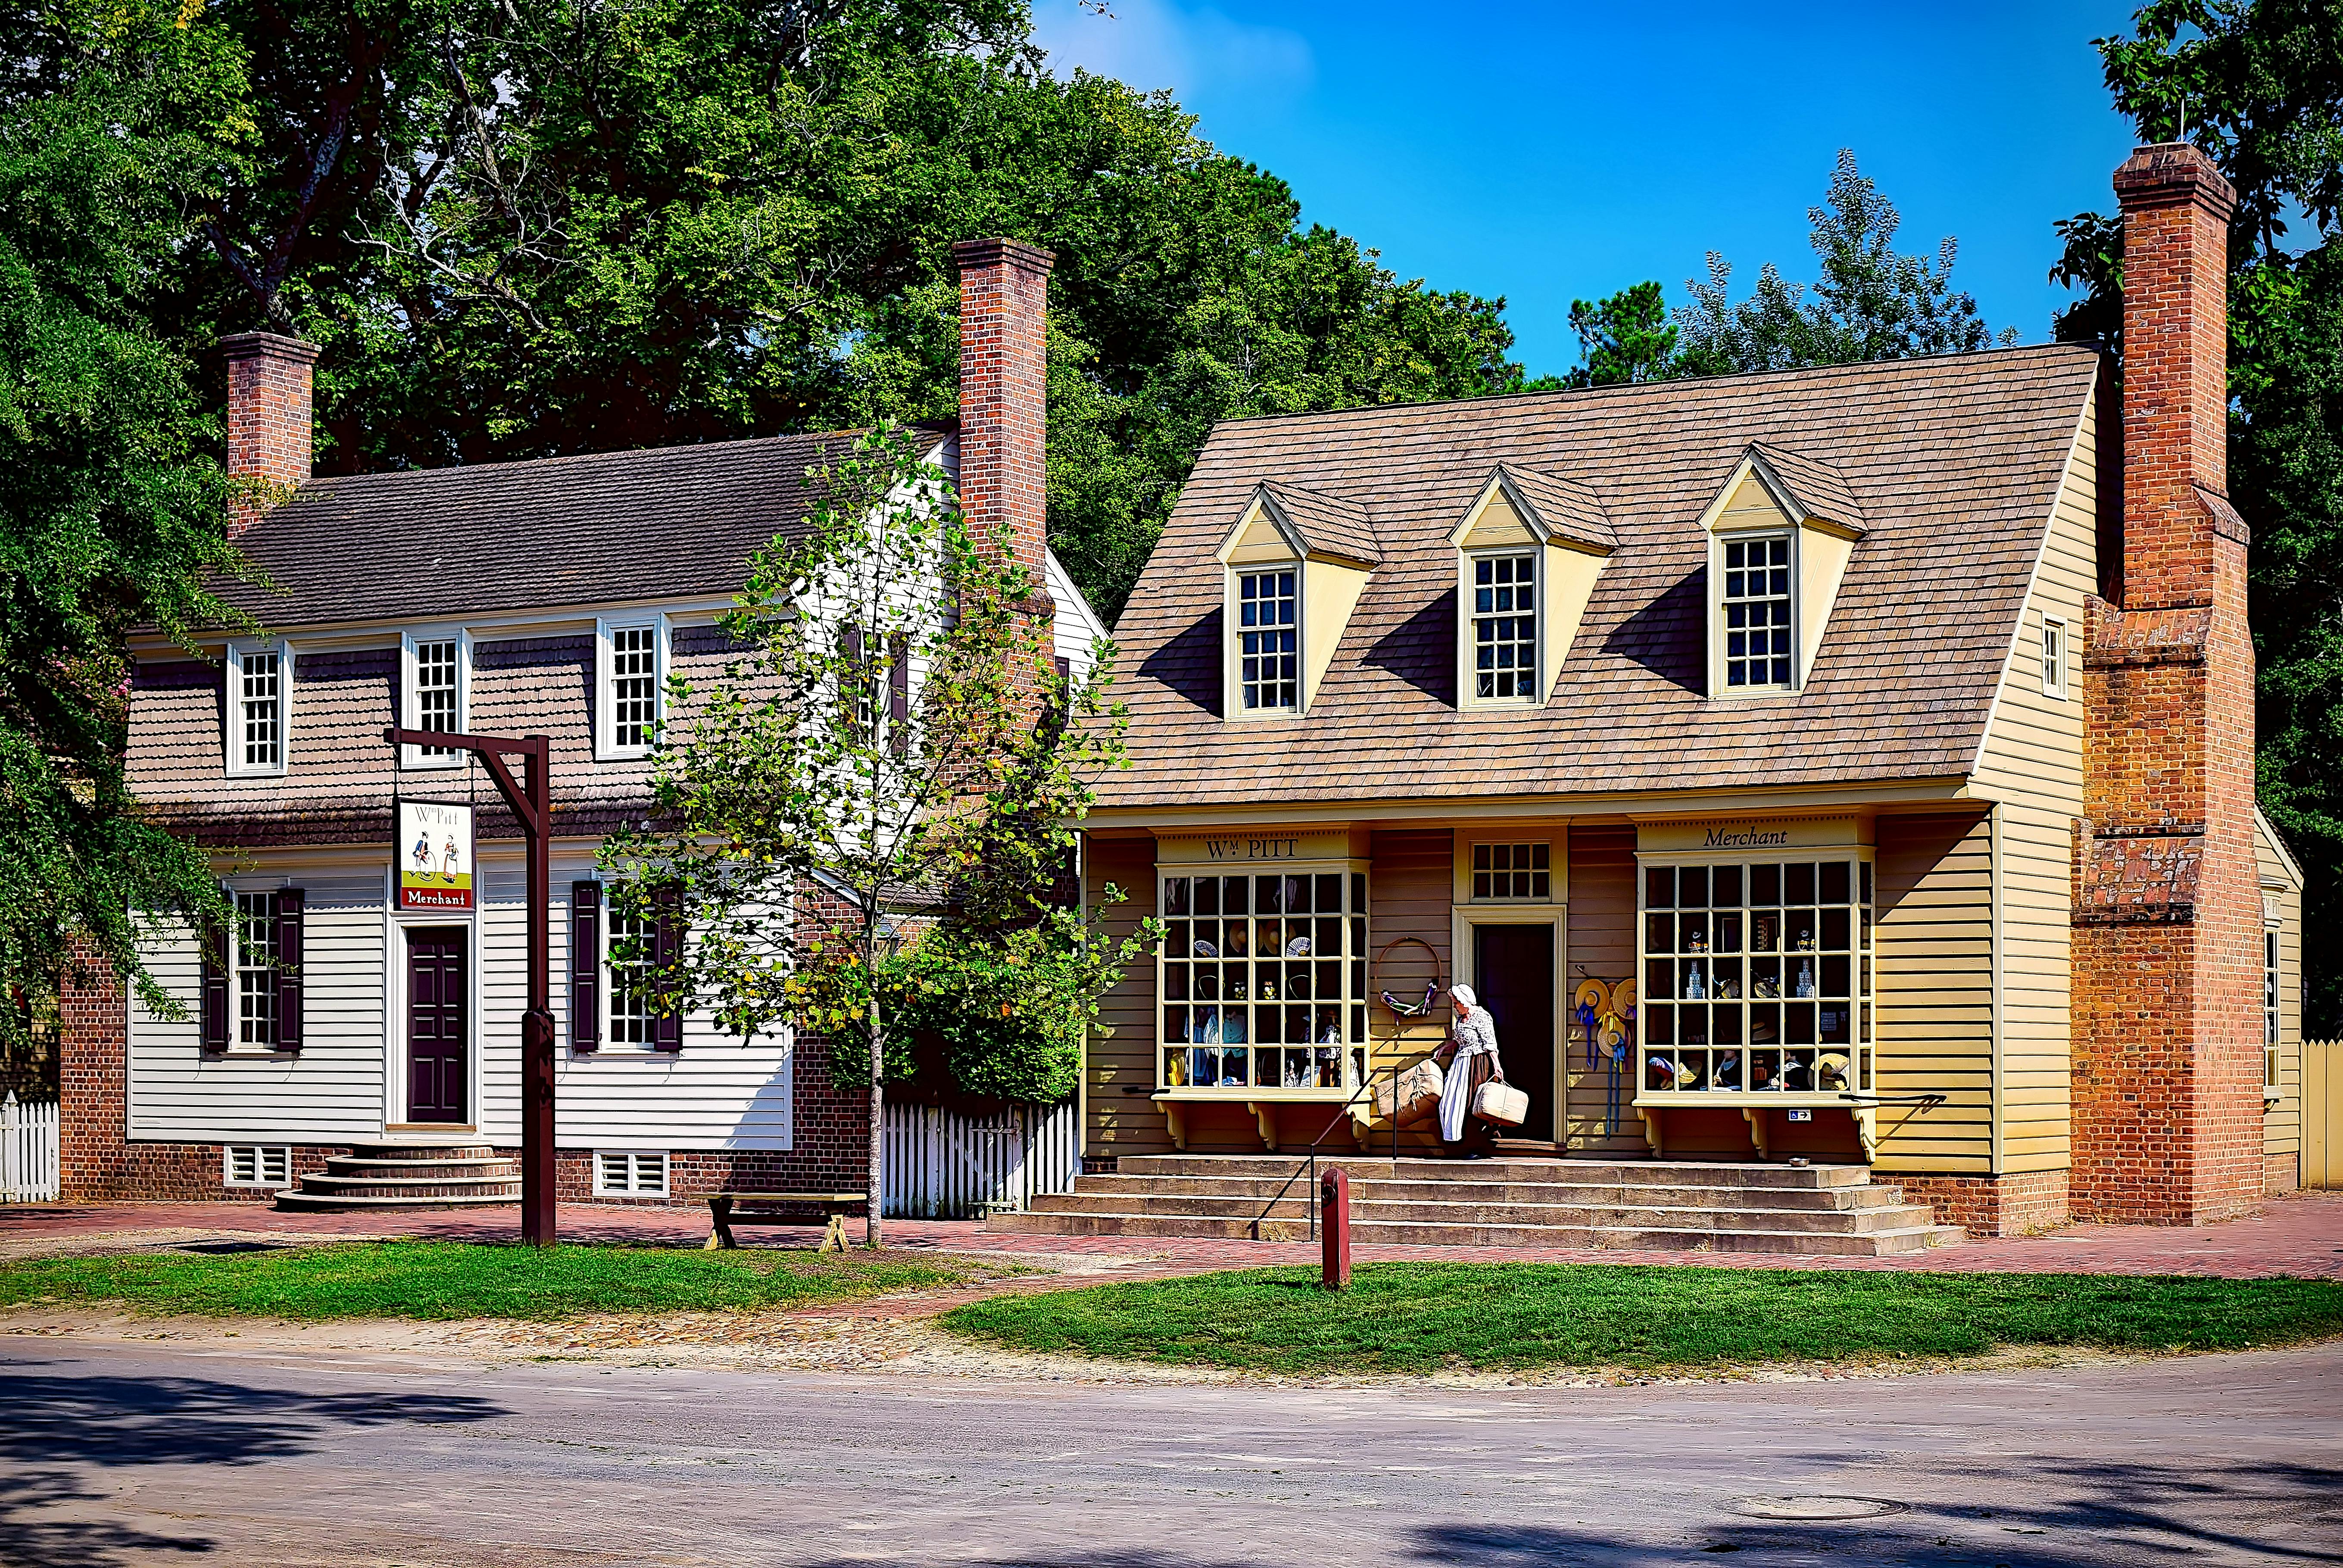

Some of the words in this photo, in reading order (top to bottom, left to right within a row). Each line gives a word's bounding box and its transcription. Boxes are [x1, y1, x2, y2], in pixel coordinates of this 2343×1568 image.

[1703, 826, 1788, 847] Merchant
[1248, 838, 1298, 858] PITT
[408, 890, 465, 905] Merchant
